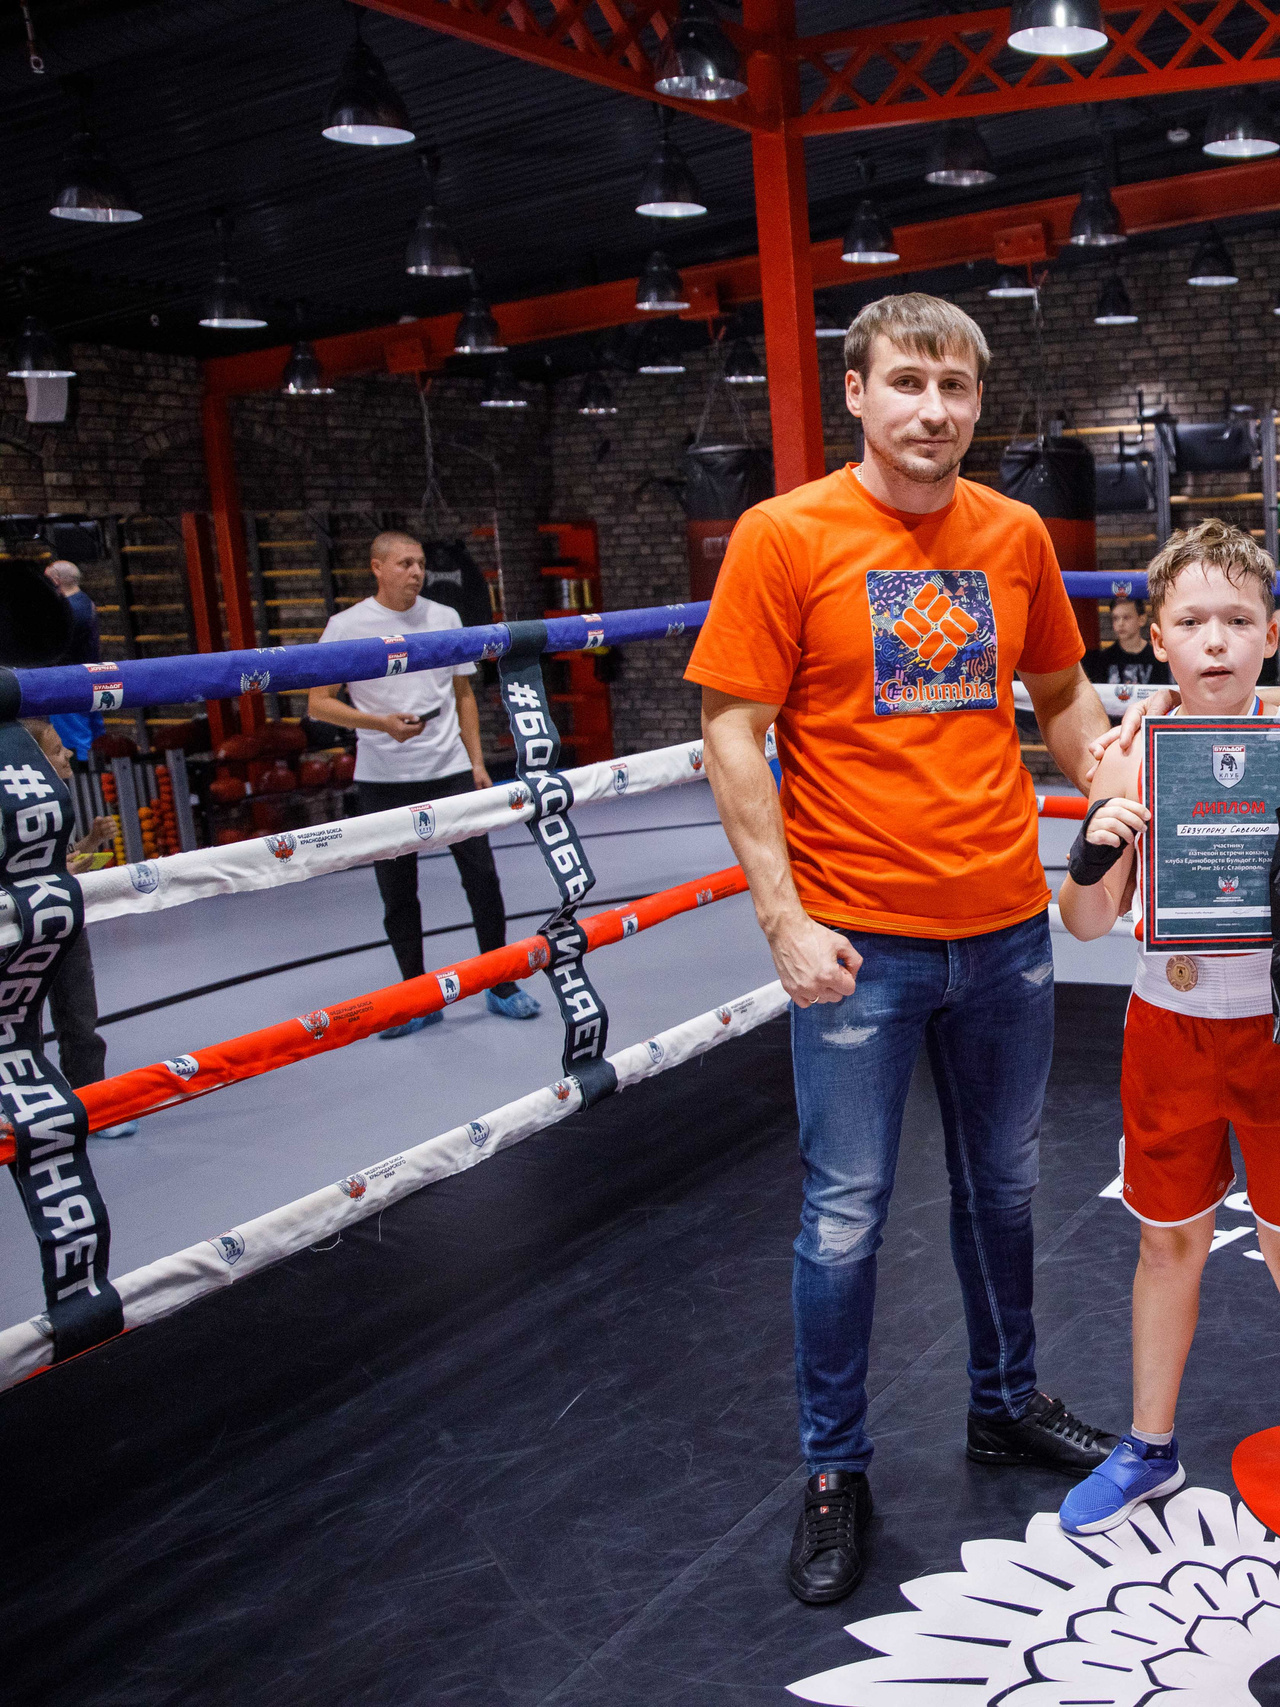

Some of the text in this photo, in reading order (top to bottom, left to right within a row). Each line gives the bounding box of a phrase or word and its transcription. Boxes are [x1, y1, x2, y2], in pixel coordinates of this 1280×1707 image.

[880, 677, 992, 703] Columbia
[1192, 801, 1266, 818] ДИПЛОМ
[300, 834, 343, 845] КРАСНОДАРСКОГО
[0, 764, 101, 1300] #БОКСОБЪЕДИНЯЕТ
[384, 1171, 396, 1179] КРАЯ
